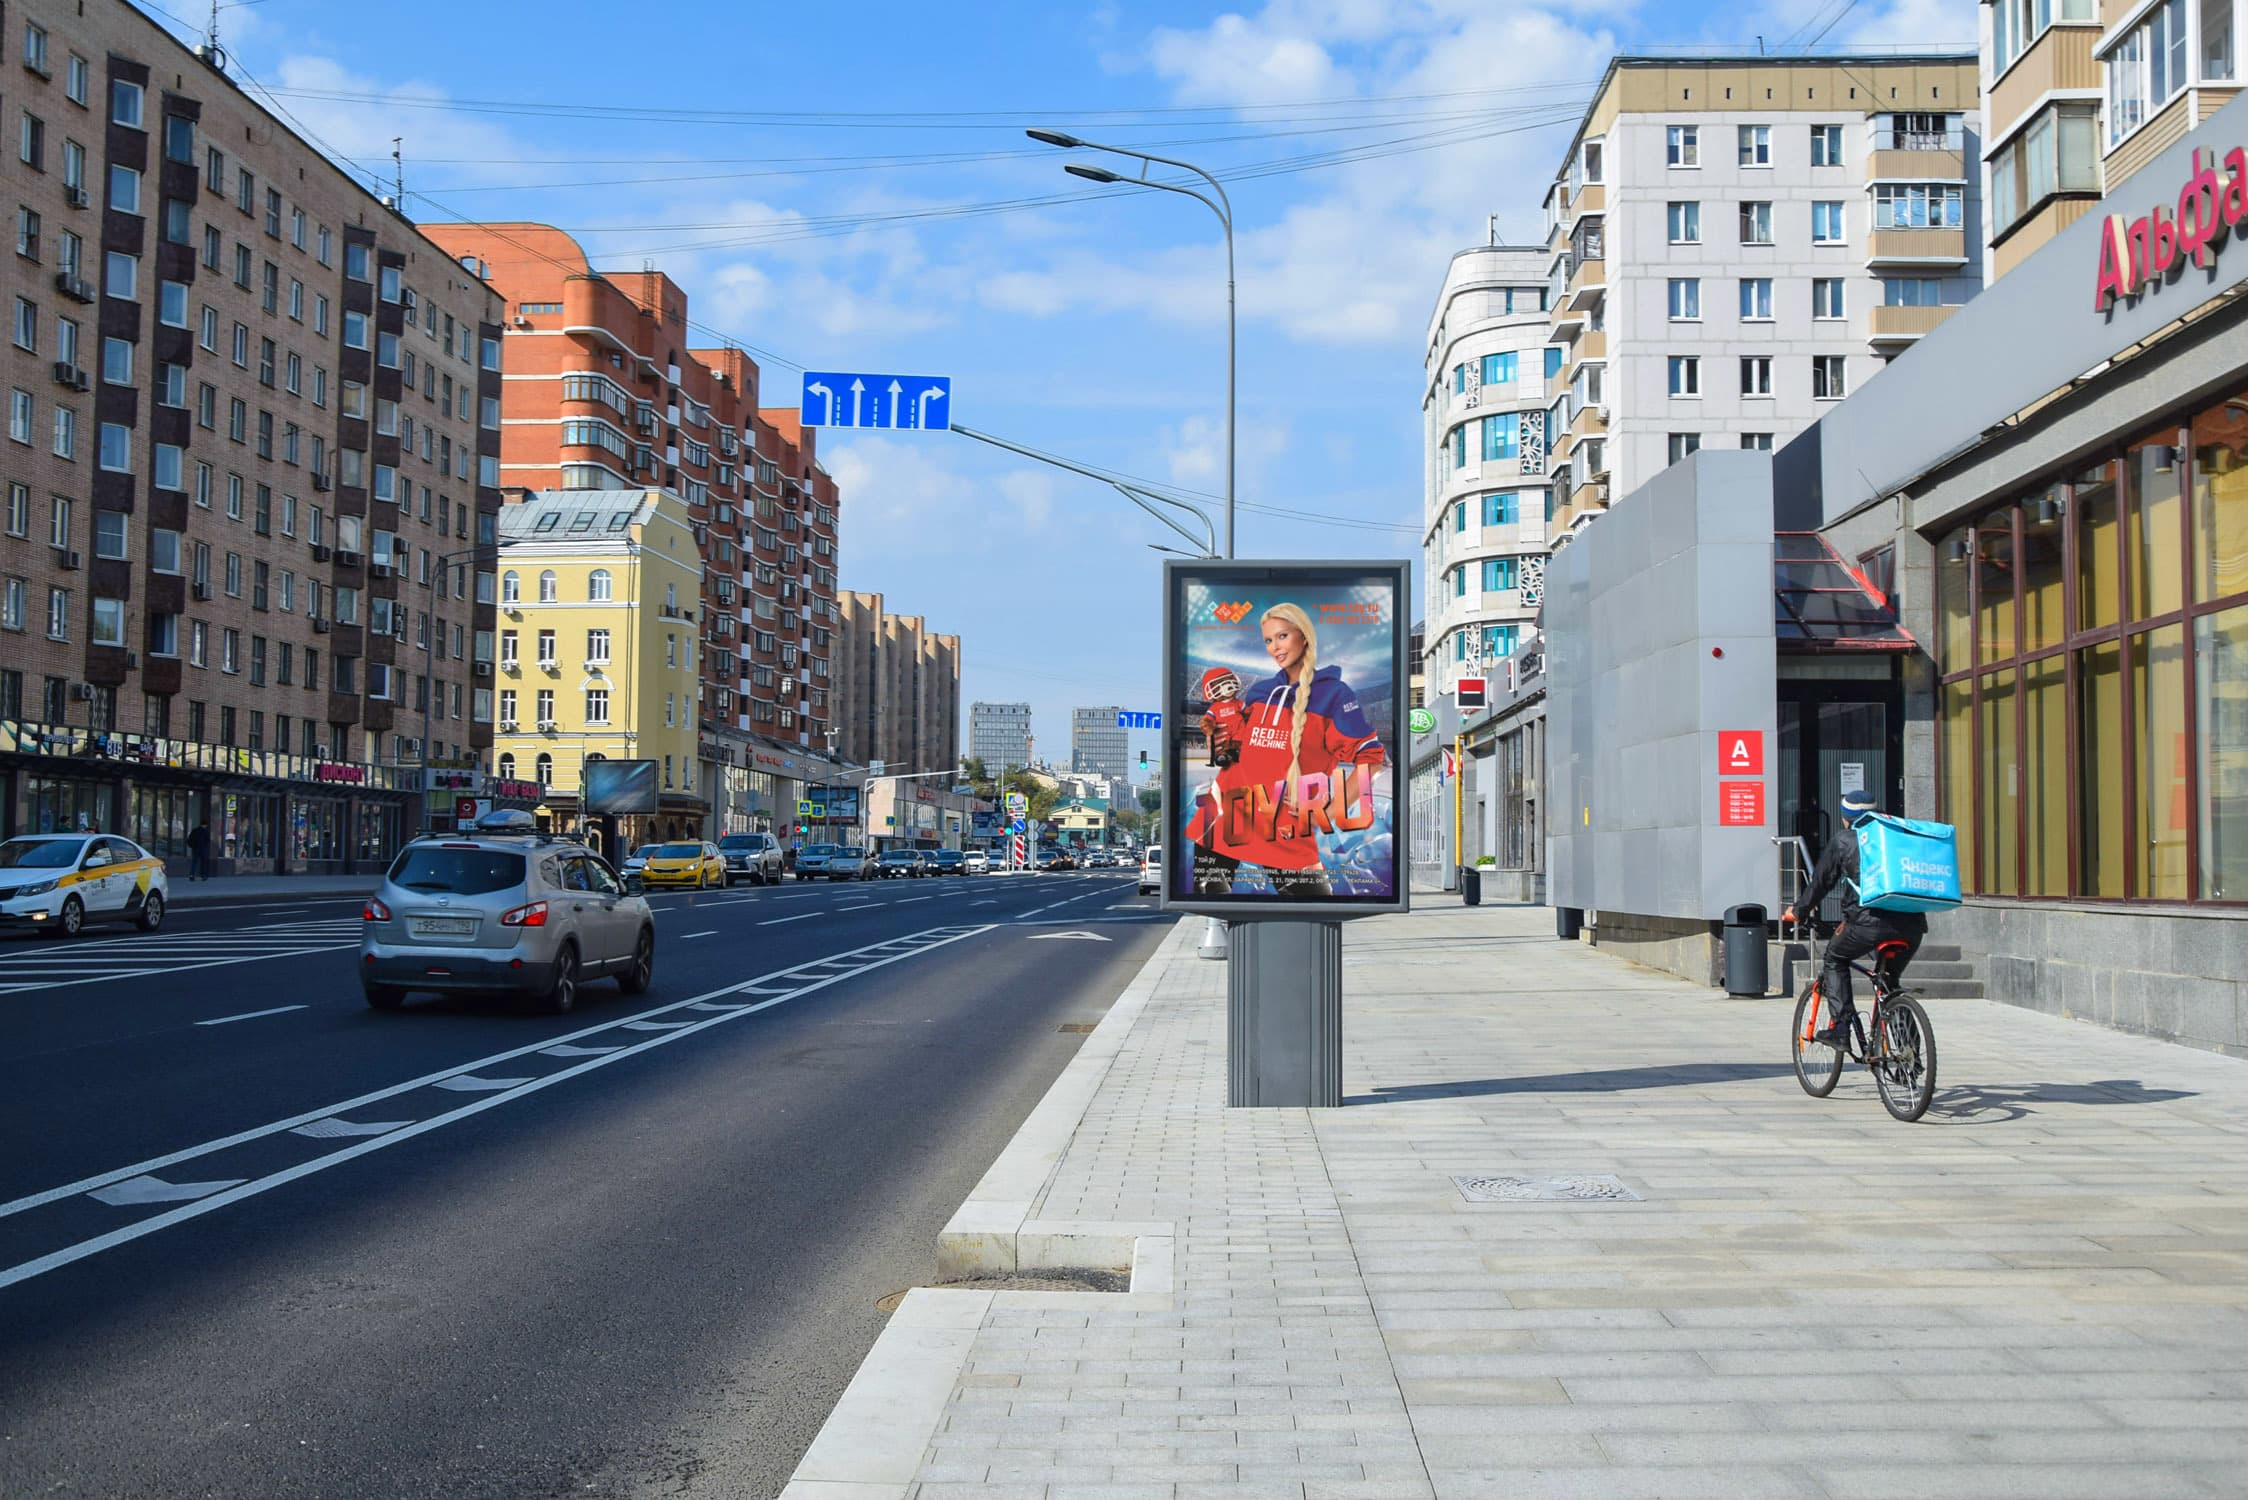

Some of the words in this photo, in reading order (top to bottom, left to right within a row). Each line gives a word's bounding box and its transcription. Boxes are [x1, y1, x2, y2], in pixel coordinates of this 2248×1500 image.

[2096, 146, 2248, 312] Альфа
[1251, 727, 1275, 739] RED
[1249, 738, 1287, 750] MACHINE
[1196, 763, 1376, 850] TOY.RU
[1900, 856, 1952, 877] Яндекс
[1901, 873, 1945, 892] Лавка
